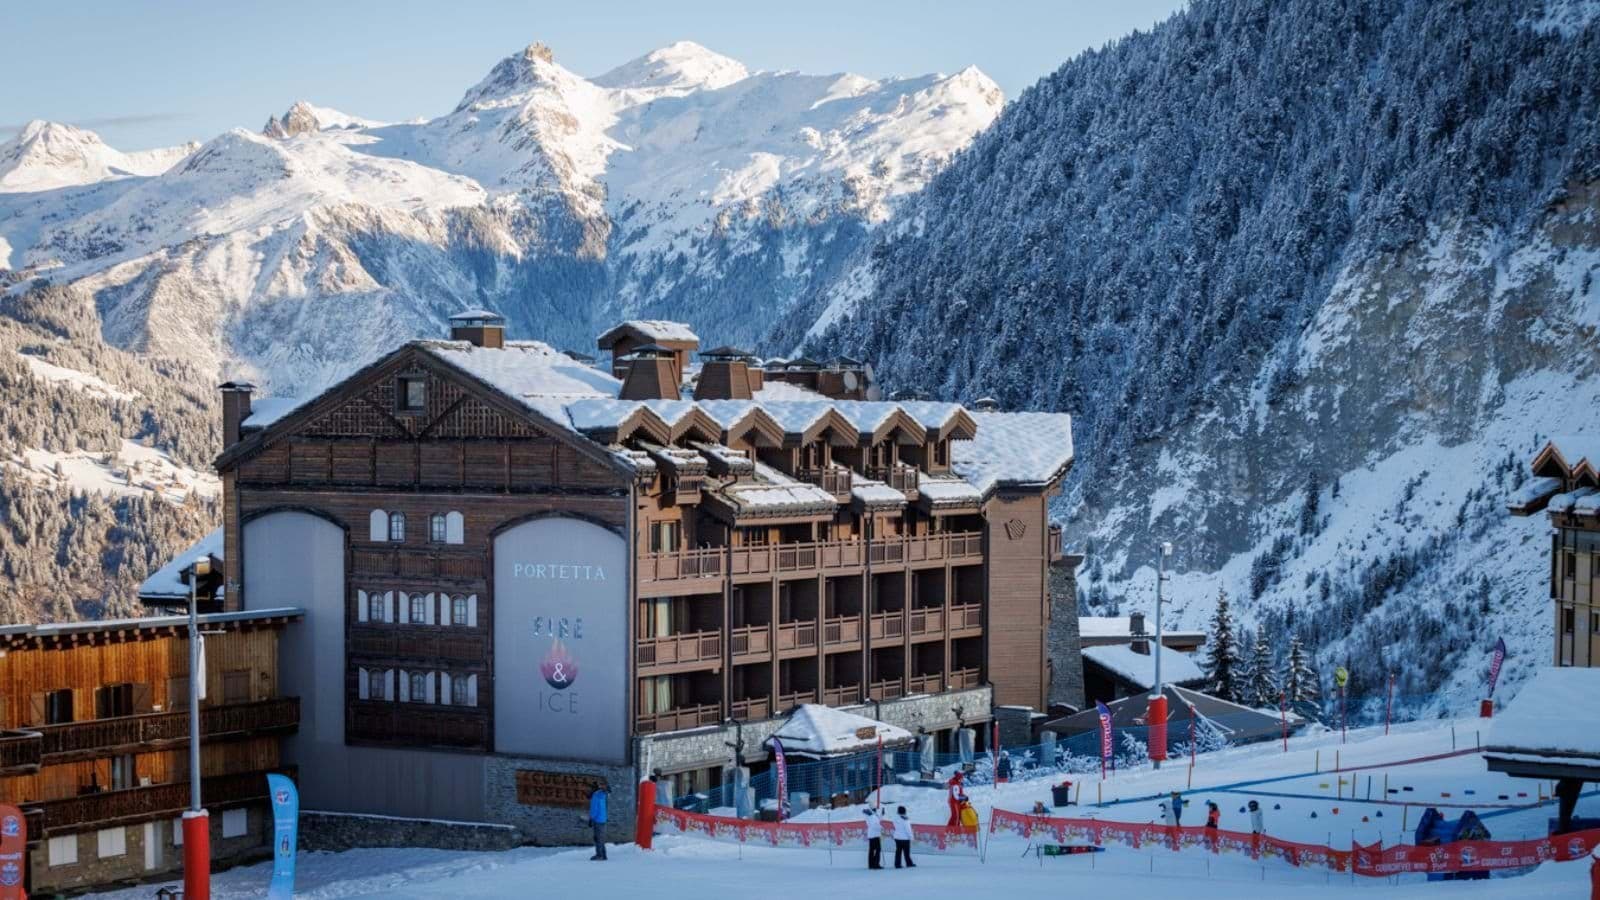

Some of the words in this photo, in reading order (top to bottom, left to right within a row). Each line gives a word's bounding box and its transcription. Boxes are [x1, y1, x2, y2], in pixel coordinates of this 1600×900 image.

[513, 563, 607, 580] PORTETTA
[533, 616, 584, 639] FIRE
[552, 662, 568, 683] &
[538, 691, 580, 714] ICE
[523, 785, 592, 800] ANGELIN
[1375, 862, 1411, 873] COVEL
